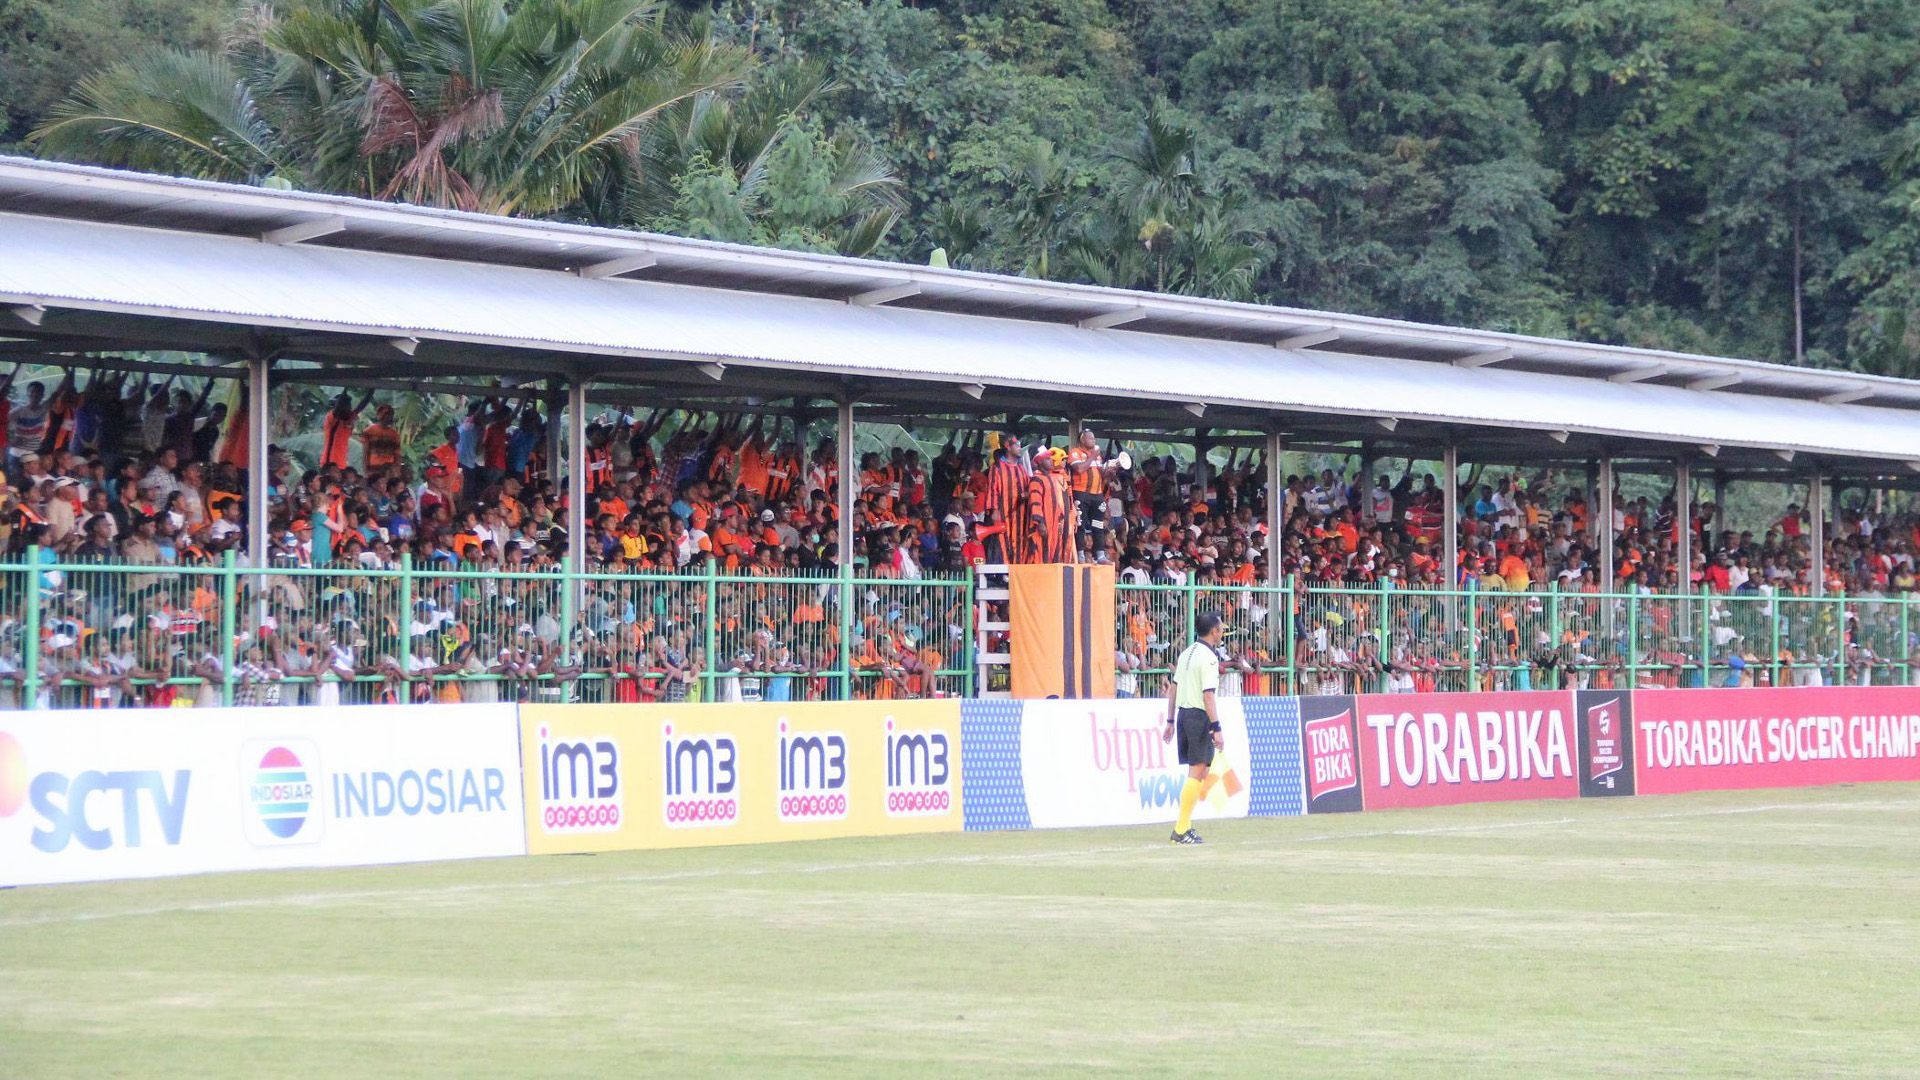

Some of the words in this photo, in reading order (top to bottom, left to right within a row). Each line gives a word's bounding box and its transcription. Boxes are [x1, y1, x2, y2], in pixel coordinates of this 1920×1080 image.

[541, 727, 618, 800] im3
[665, 725, 736, 795] im3
[781, 722, 846, 790] im3
[888, 720, 949, 787] im3
[1088, 711, 1167, 793] btpn
[1309, 724, 1350, 755] TORA
[1367, 709, 1573, 787] TORABIKA
[1640, 718, 1764, 769] TORABIKA
[1767, 716, 1847, 763] SOCCER
[1849, 715, 1920, 758] CHAMP
[251, 784, 313, 800] INDOSIAR
[333, 768, 506, 818] INDOSIAR
[1314, 754, 1353, 784] BIKA
[28, 768, 192, 853] SCTV
[545, 803, 619, 828] ooredoo
[667, 798, 736, 822] ooredoo
[781, 794, 846, 816] ooredoo
[888, 790, 949, 812] ooredoo
